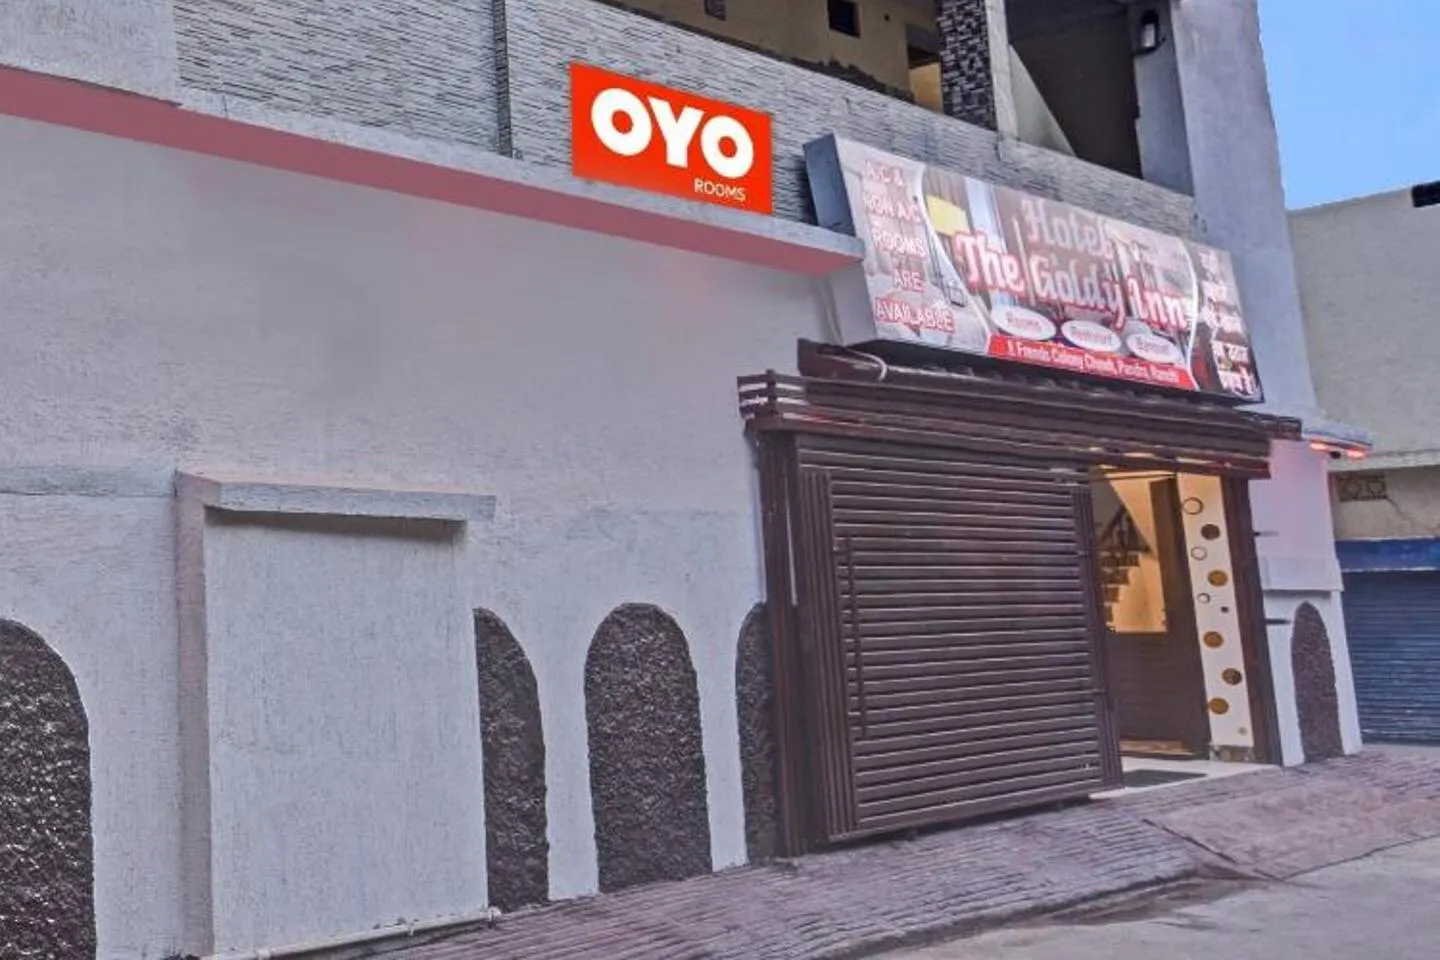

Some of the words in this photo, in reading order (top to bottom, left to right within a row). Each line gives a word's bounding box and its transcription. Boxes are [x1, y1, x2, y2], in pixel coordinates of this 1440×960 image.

[591, 88, 754, 179] OYO
[694, 178, 746, 202] ROOMS
[1021, 198, 1113, 259] Hotel
[893, 268, 925, 292] ARE
[954, 228, 1025, 295] The
[875, 297, 956, 333] AVAILABLE
